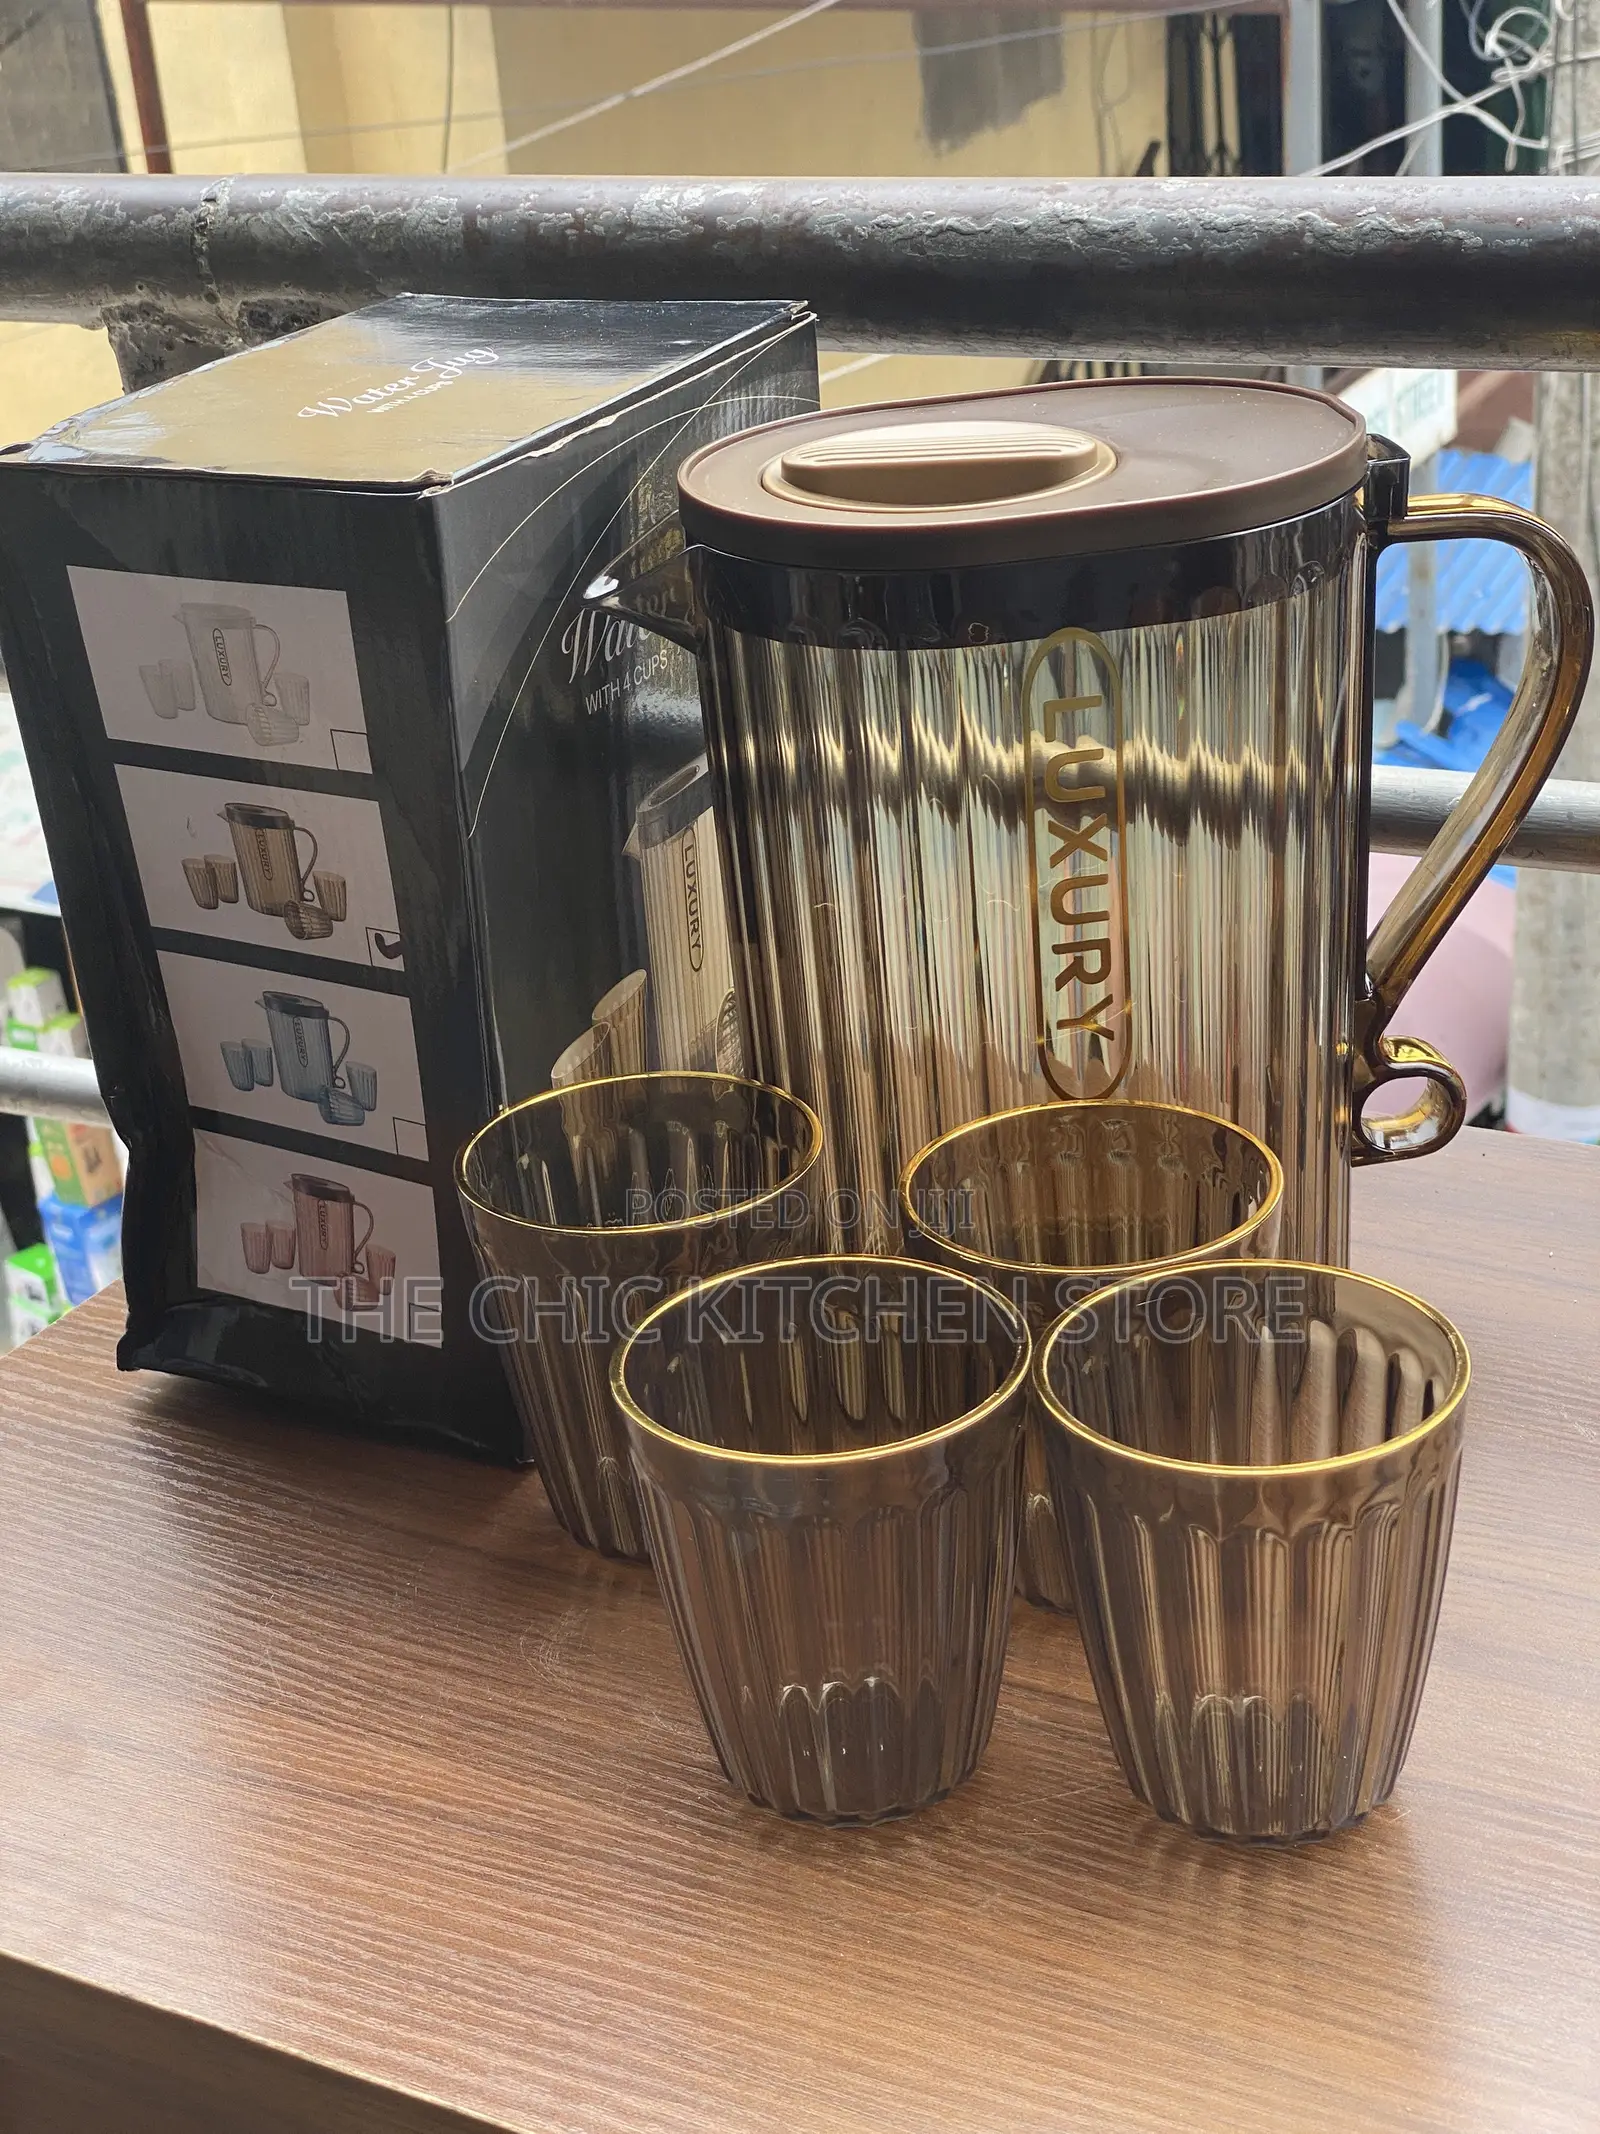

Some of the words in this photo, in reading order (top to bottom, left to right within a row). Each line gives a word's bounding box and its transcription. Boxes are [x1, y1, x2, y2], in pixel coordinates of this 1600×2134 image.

[297, 374, 420, 418] Water
[410, 347, 500, 380] Jug
[215, 635, 231, 680] LUXURY
[585, 678, 621, 715] WITH
[623, 671, 631, 691] 4
[633, 649, 668, 686] CUPS
[684, 847, 702, 951] LUXURY
[1043, 695, 1115, 1041] LUXURY
